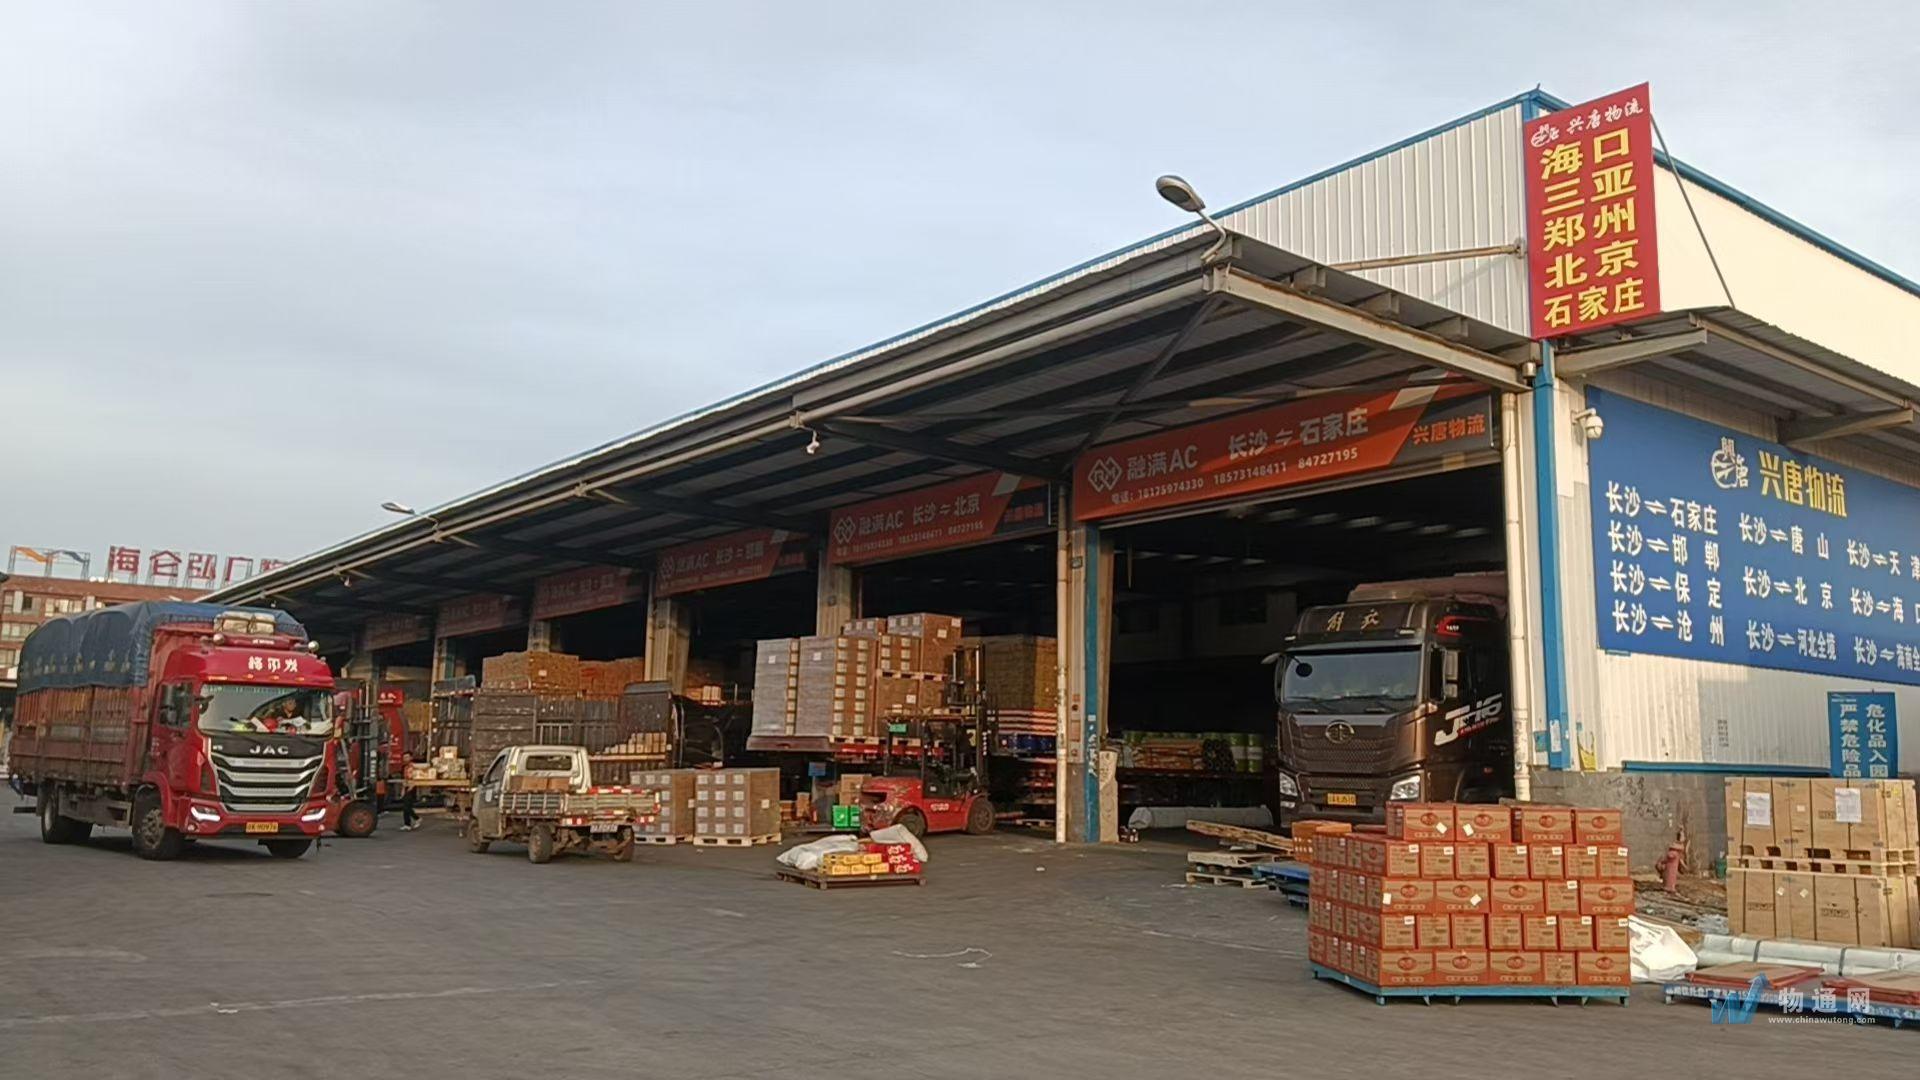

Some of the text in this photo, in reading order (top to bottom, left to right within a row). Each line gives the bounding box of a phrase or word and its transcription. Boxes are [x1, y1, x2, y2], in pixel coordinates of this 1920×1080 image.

[1566, 98, 1644, 135] 兴唐物流
[1541, 128, 1630, 179] 海口
[1541, 162, 1637, 215] 三亚
[1543, 197, 1636, 251] 郑州
[1544, 239, 1639, 289] 北京
[1544, 278, 1645, 328] 石家庄
[1126, 444, 1199, 480] 融满AC
[1227, 427, 1268, 460] 长沙
[1299, 407, 1369, 446] 石家庄
[1412, 413, 1486, 445] 兴唐物流
[1213, 461, 1287, 485] 18573148411
[1298, 448, 1359, 469] 84727195
[1759, 450, 1848, 518] 兴唐物流
[953, 493, 981, 517] 北京
[1605, 480, 1719, 535] 长沙 石家庄
[1607, 519, 1721, 573] 长沙 邯郸
[1739, 512, 1830, 560] 长沙 唐山
[1847, 539, 1871, 568] 长沙
[1609, 560, 1722, 609] 长沙 保定
[1743, 566, 1834, 609] 长沙 北京
[1851, 587, 1874, 617] 长沙
[1612, 600, 1726, 646] 长沙 沧州
[1746, 619, 1837, 661] 长沙 河北全境
[1854, 636, 1877, 666] 长沙
[249, 745, 289, 755] JAC
[1840, 703, 1861, 778] 严禁危险品
[1865, 703, 1889, 778] 危化品入园
